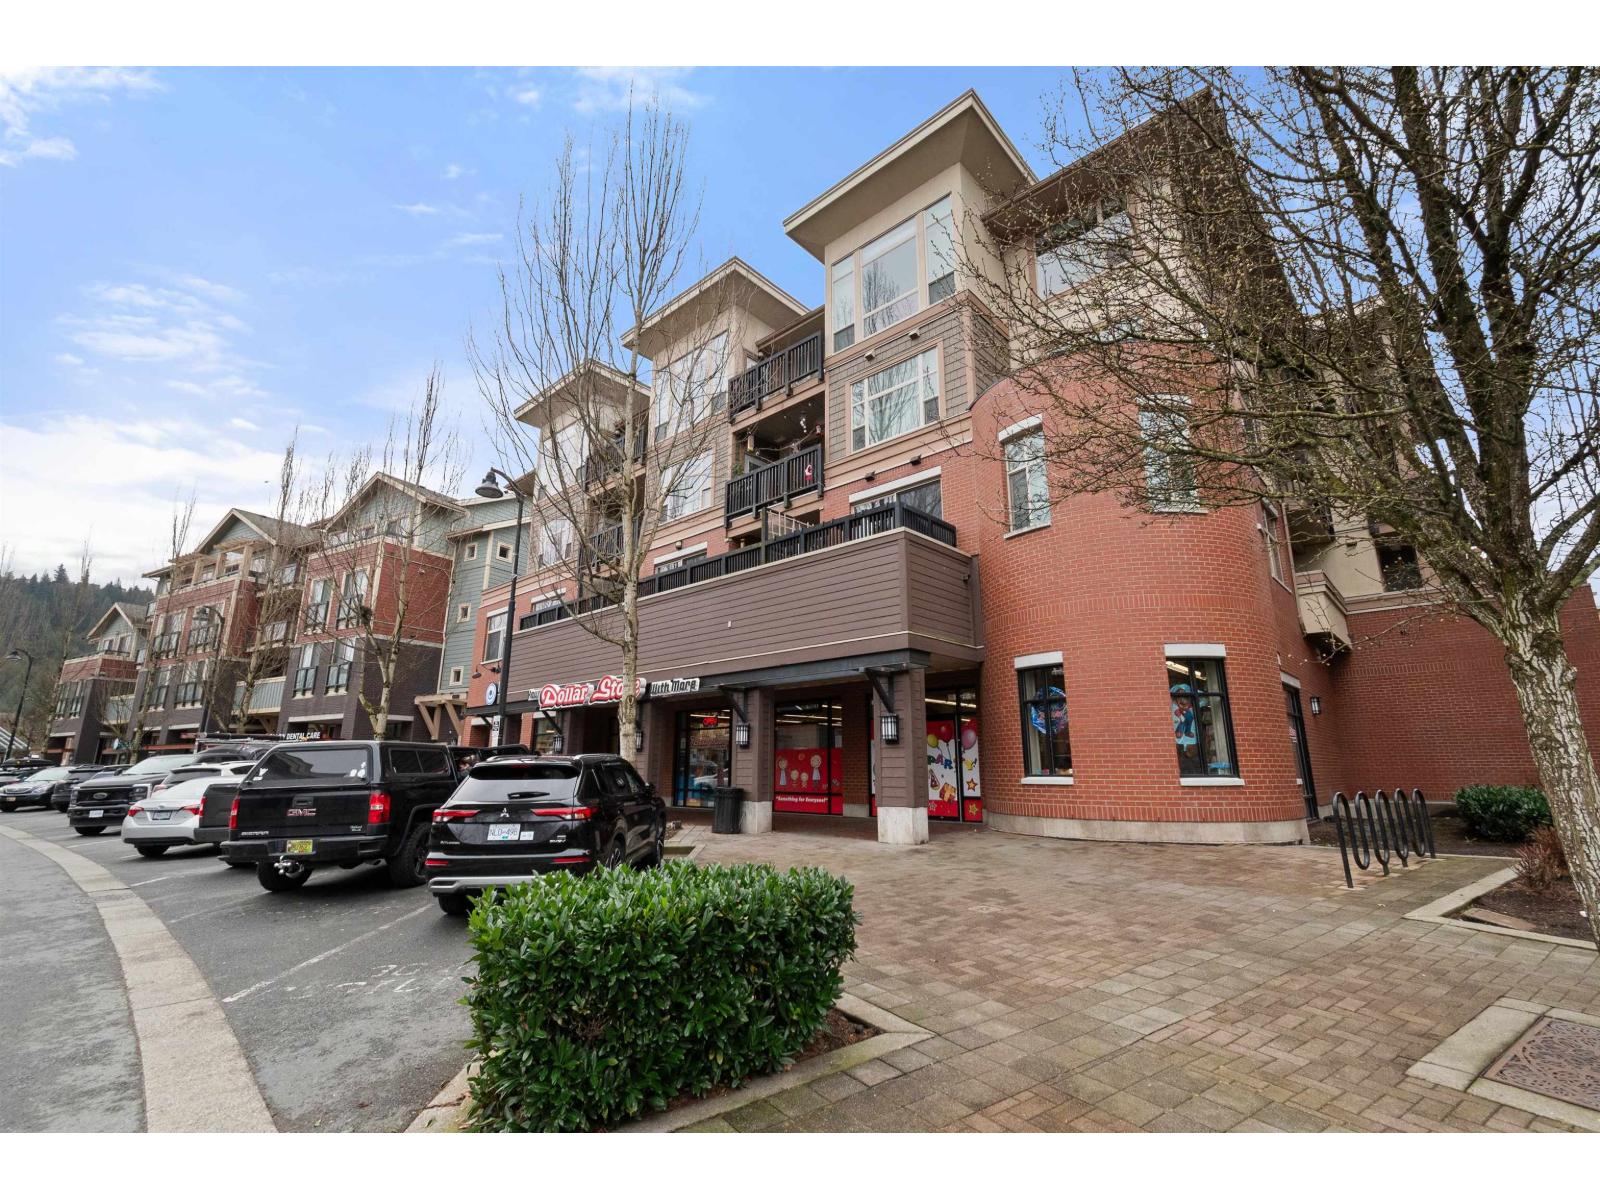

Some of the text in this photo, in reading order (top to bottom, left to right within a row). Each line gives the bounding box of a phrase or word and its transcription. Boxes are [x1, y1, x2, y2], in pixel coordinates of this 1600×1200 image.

[540, 684, 588, 706] Dollar
[590, 675, 640, 702] Sto
[671, 679, 697, 691] More
[286, 732, 306, 740] DENTAL
[306, 731, 321, 739] CARE
[287, 807, 317, 817] GMC
